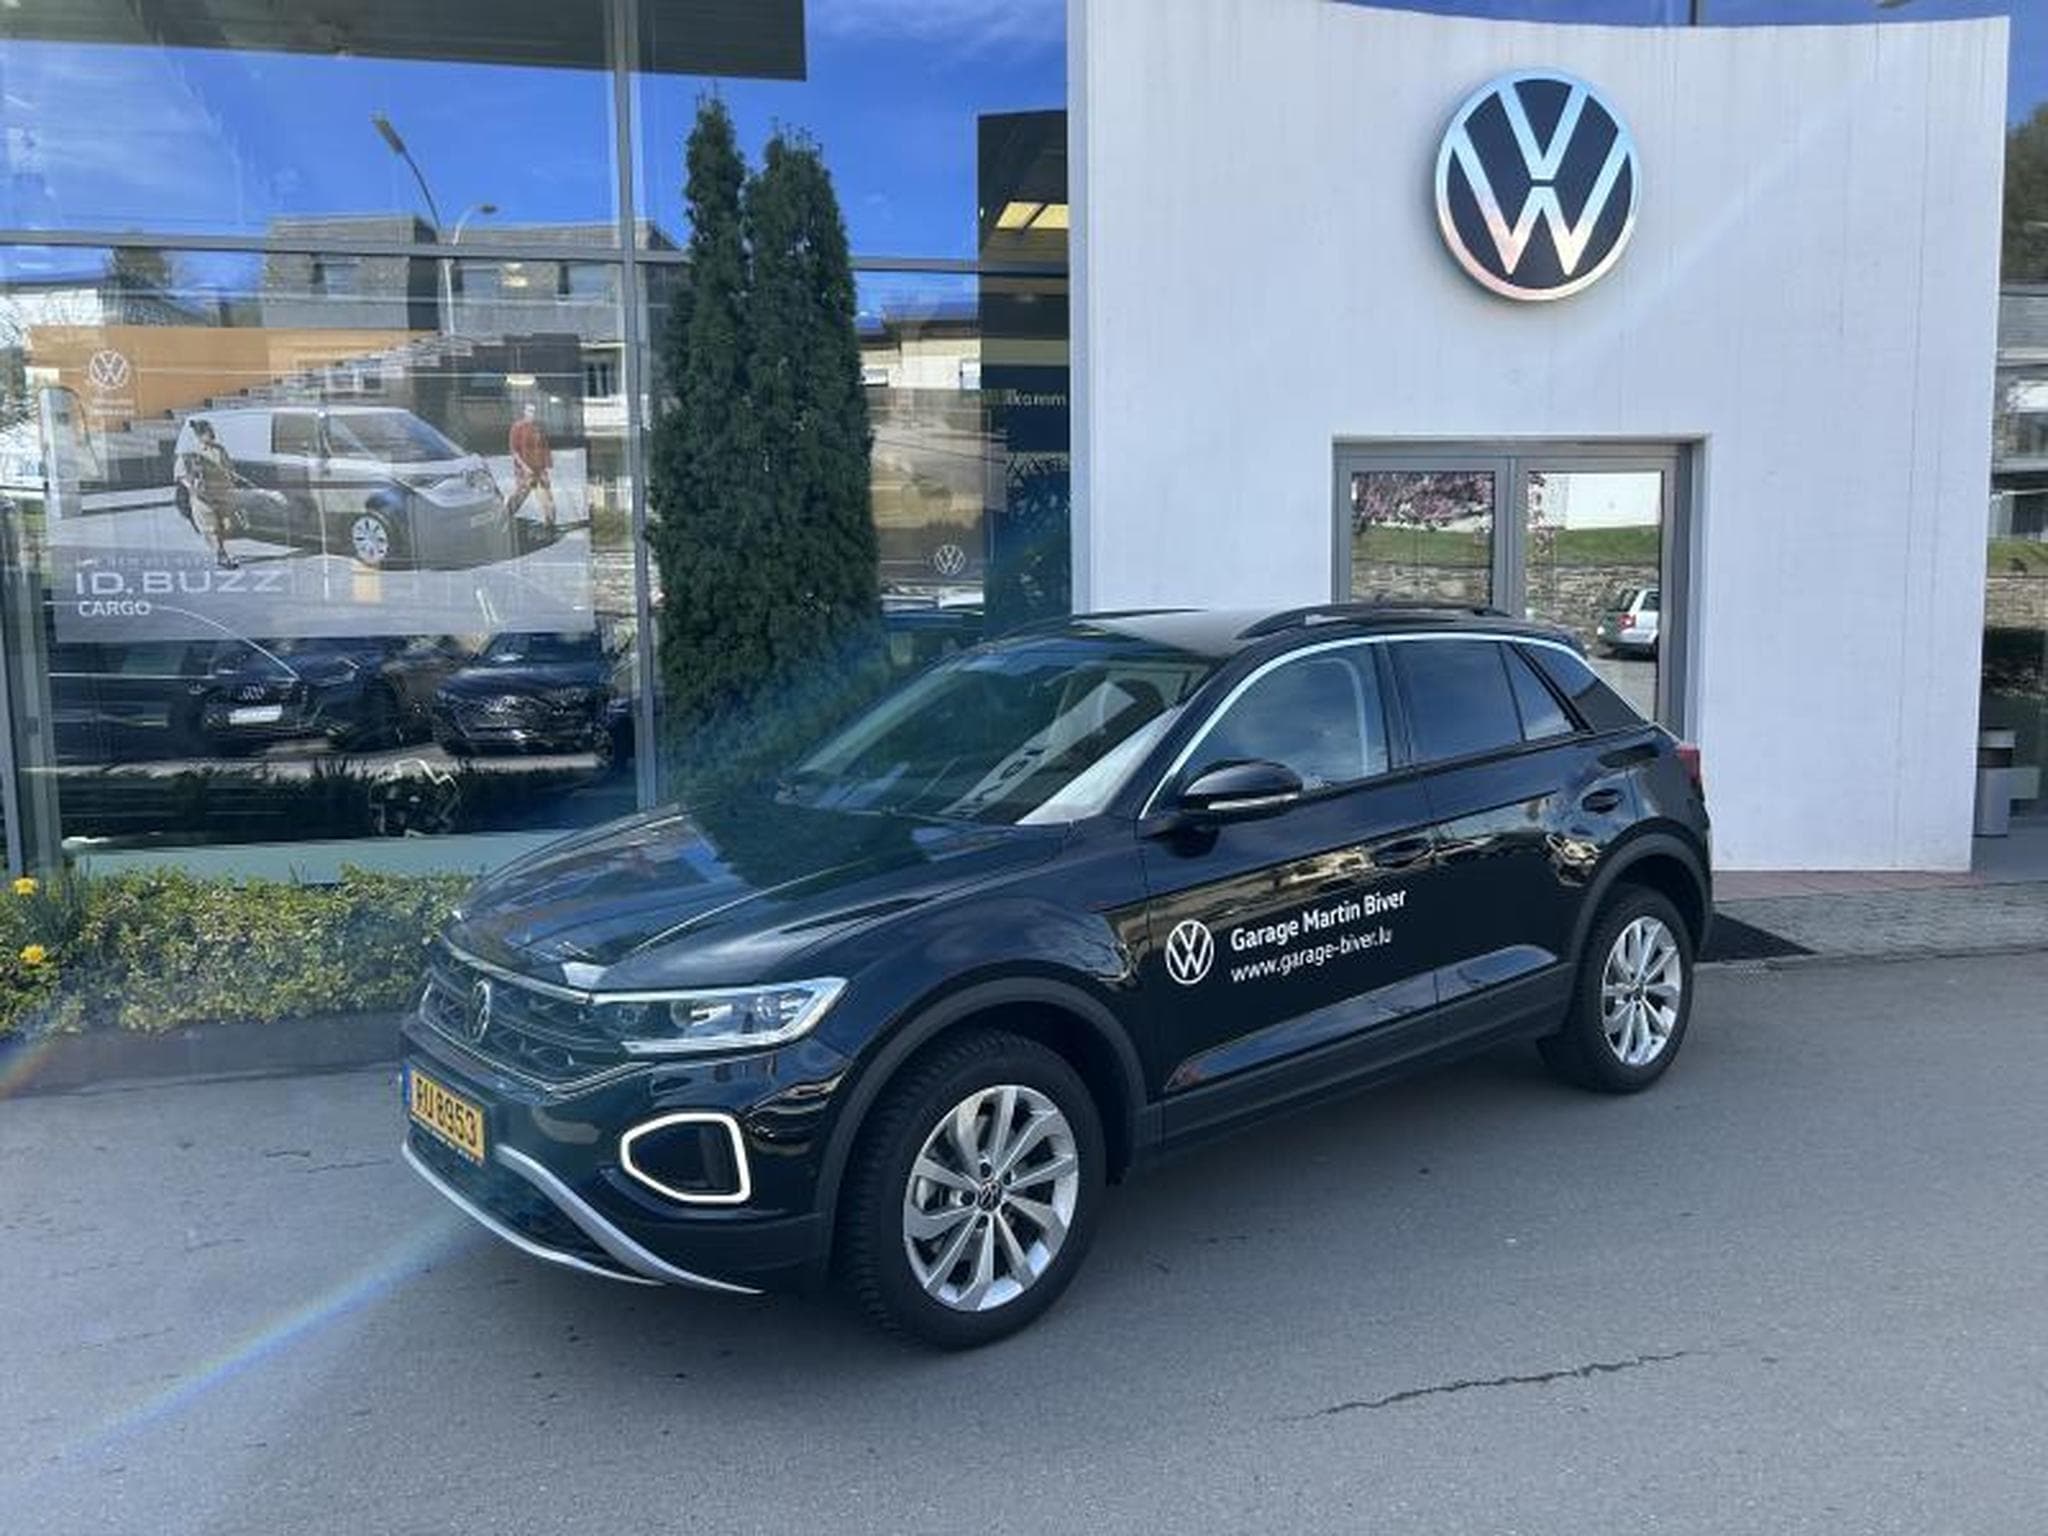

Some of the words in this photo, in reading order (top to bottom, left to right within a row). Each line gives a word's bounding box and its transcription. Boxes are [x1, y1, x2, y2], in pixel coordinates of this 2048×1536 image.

[1436, 68, 1638, 301] VW
[78, 600, 151, 617] CARGO
[1230, 919, 1299, 951] Garage
[1302, 900, 1361, 933] Martin
[1363, 890, 1407, 916] Biver
[1165, 919, 1214, 985] VW
[1230, 925, 1394, 983] www.garage-biver.lu
